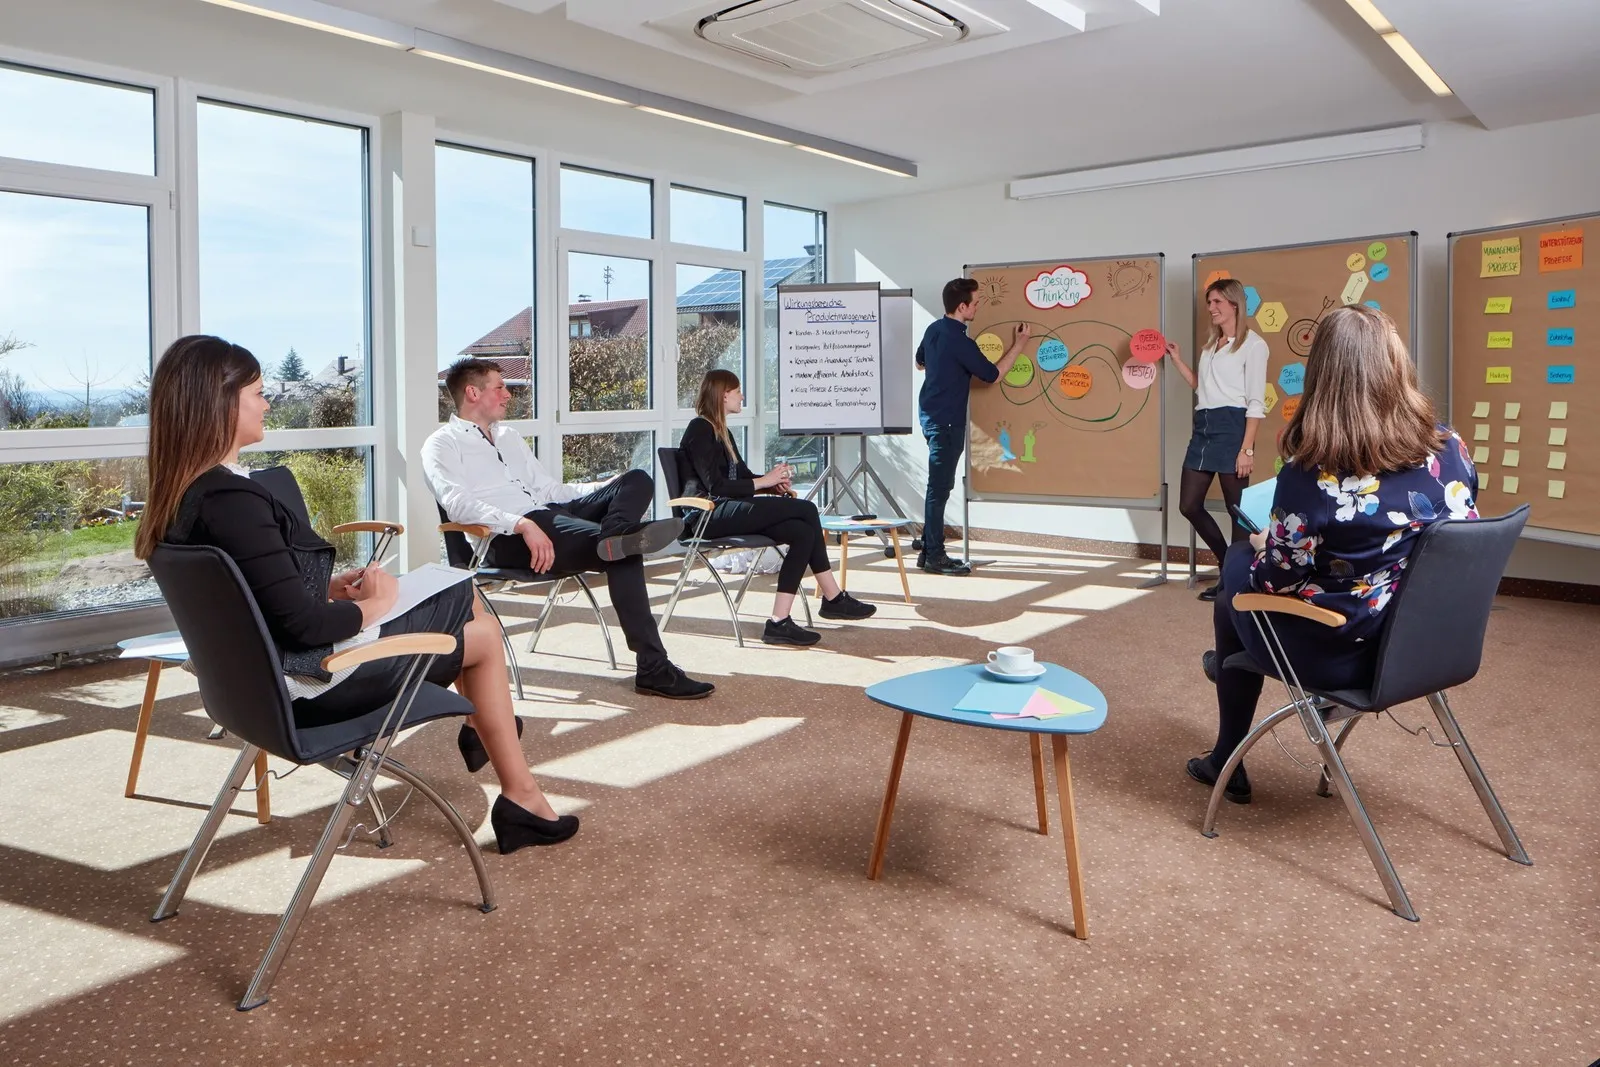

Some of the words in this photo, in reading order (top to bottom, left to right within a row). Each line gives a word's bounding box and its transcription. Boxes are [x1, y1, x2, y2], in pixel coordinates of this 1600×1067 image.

[1042, 274, 1079, 292] Design
[1034, 289, 1080, 303] Thinking
[805, 311, 877, 324] Produktmanagement
[1265, 309, 1279, 327] 3.
[1138, 334, 1159, 343] IDEEN
[979, 343, 1002, 352] ERSTEHEN
[1126, 365, 1156, 380] TESTEN
